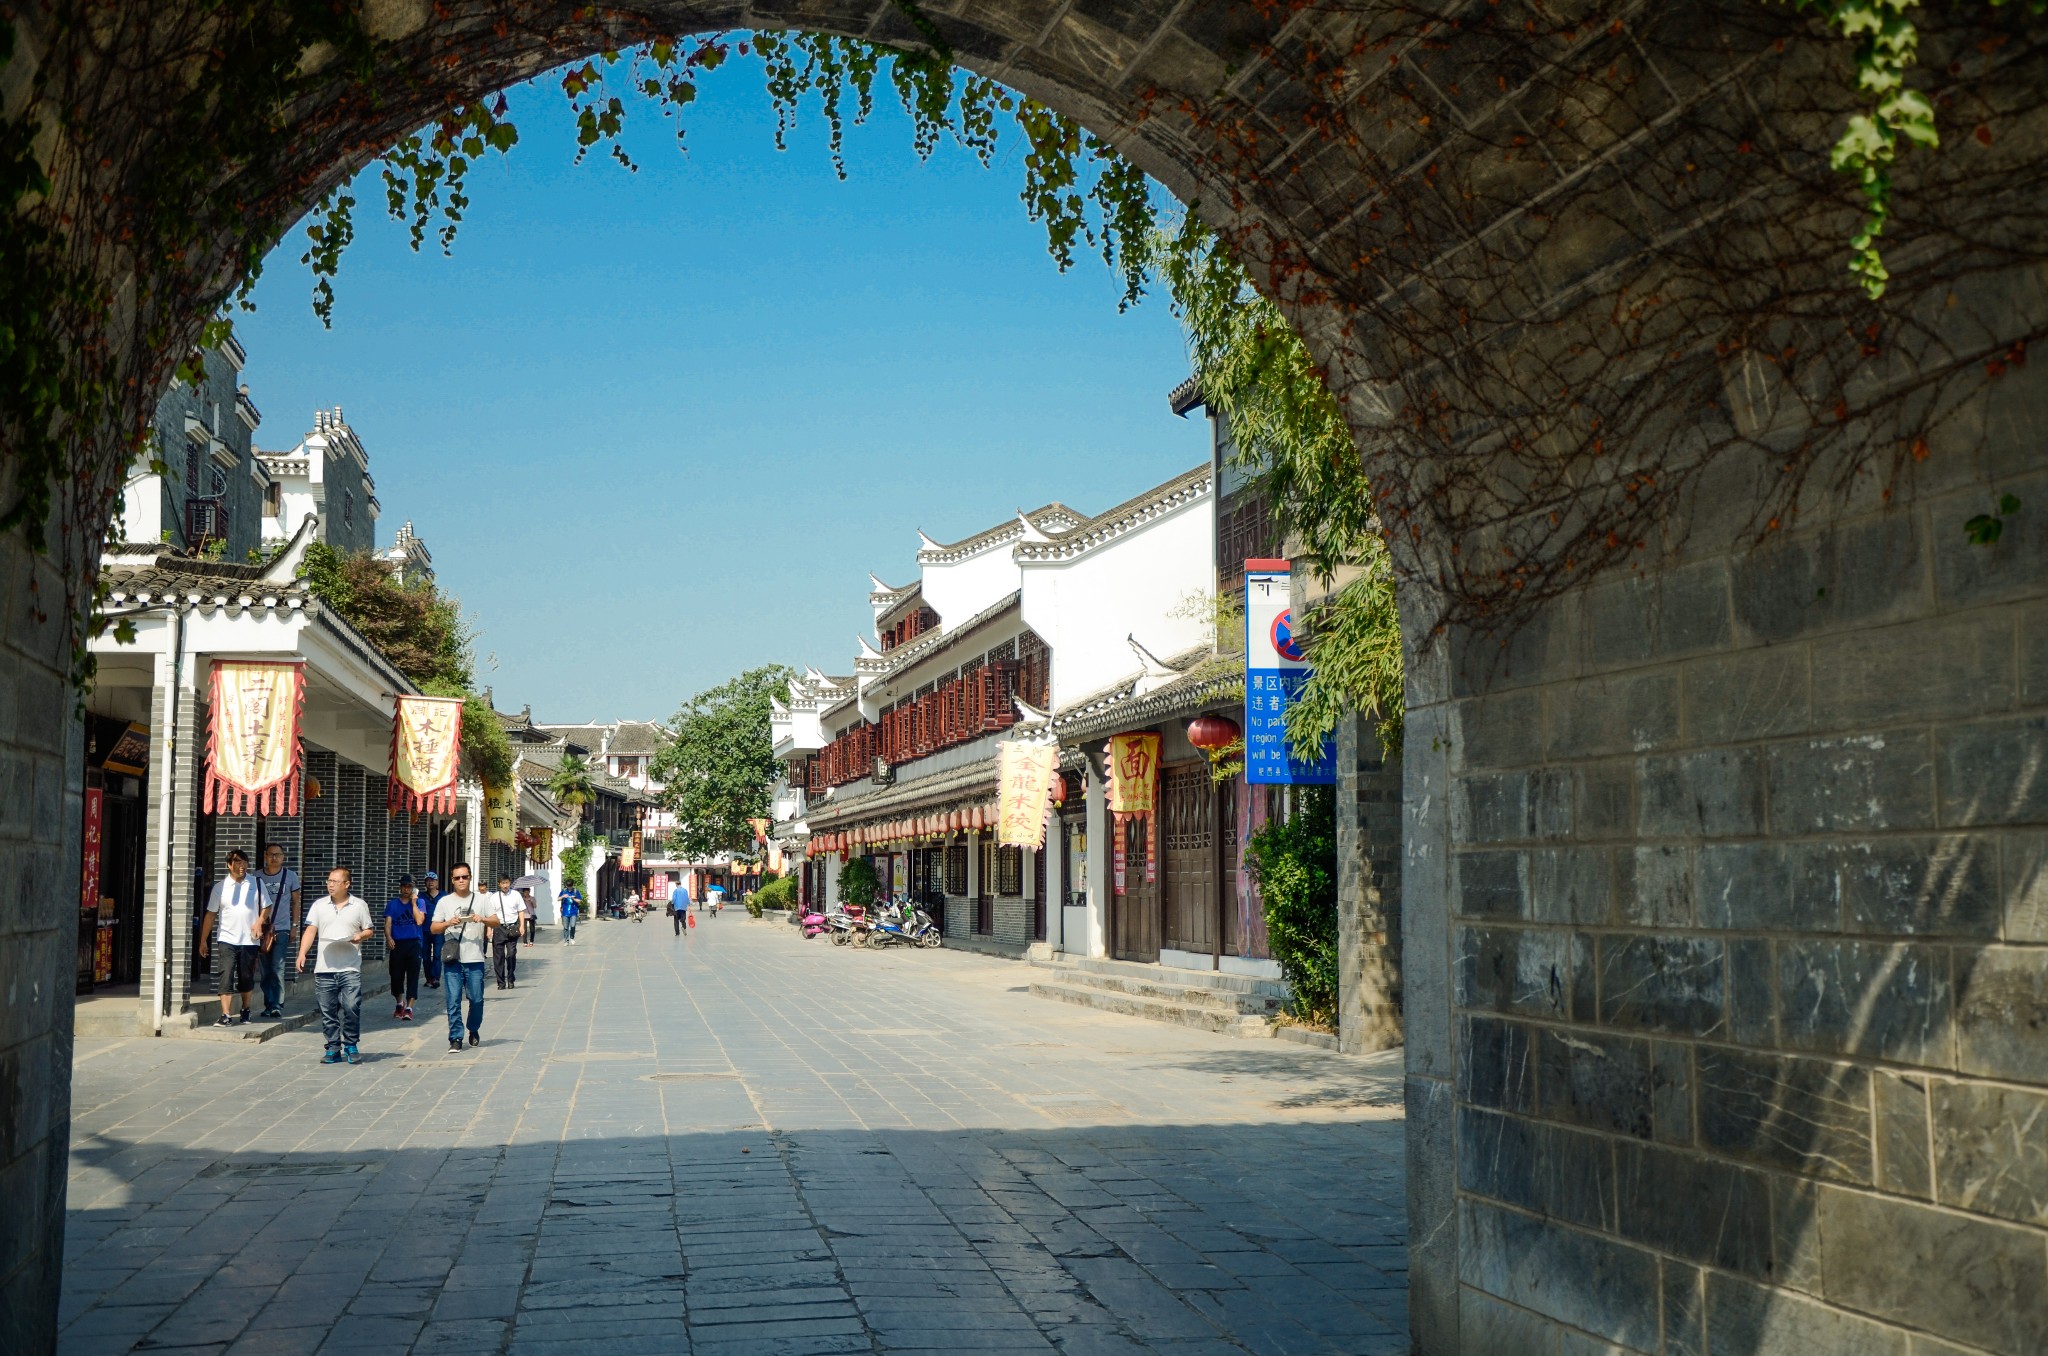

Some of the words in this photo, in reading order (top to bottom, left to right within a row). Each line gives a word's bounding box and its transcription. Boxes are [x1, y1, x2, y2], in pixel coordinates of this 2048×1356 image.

[1251, 716, 1263, 727] No
[1251, 732, 1278, 746] region
[1251, 749, 1266, 760] will
[1271, 750, 1282, 760] be
